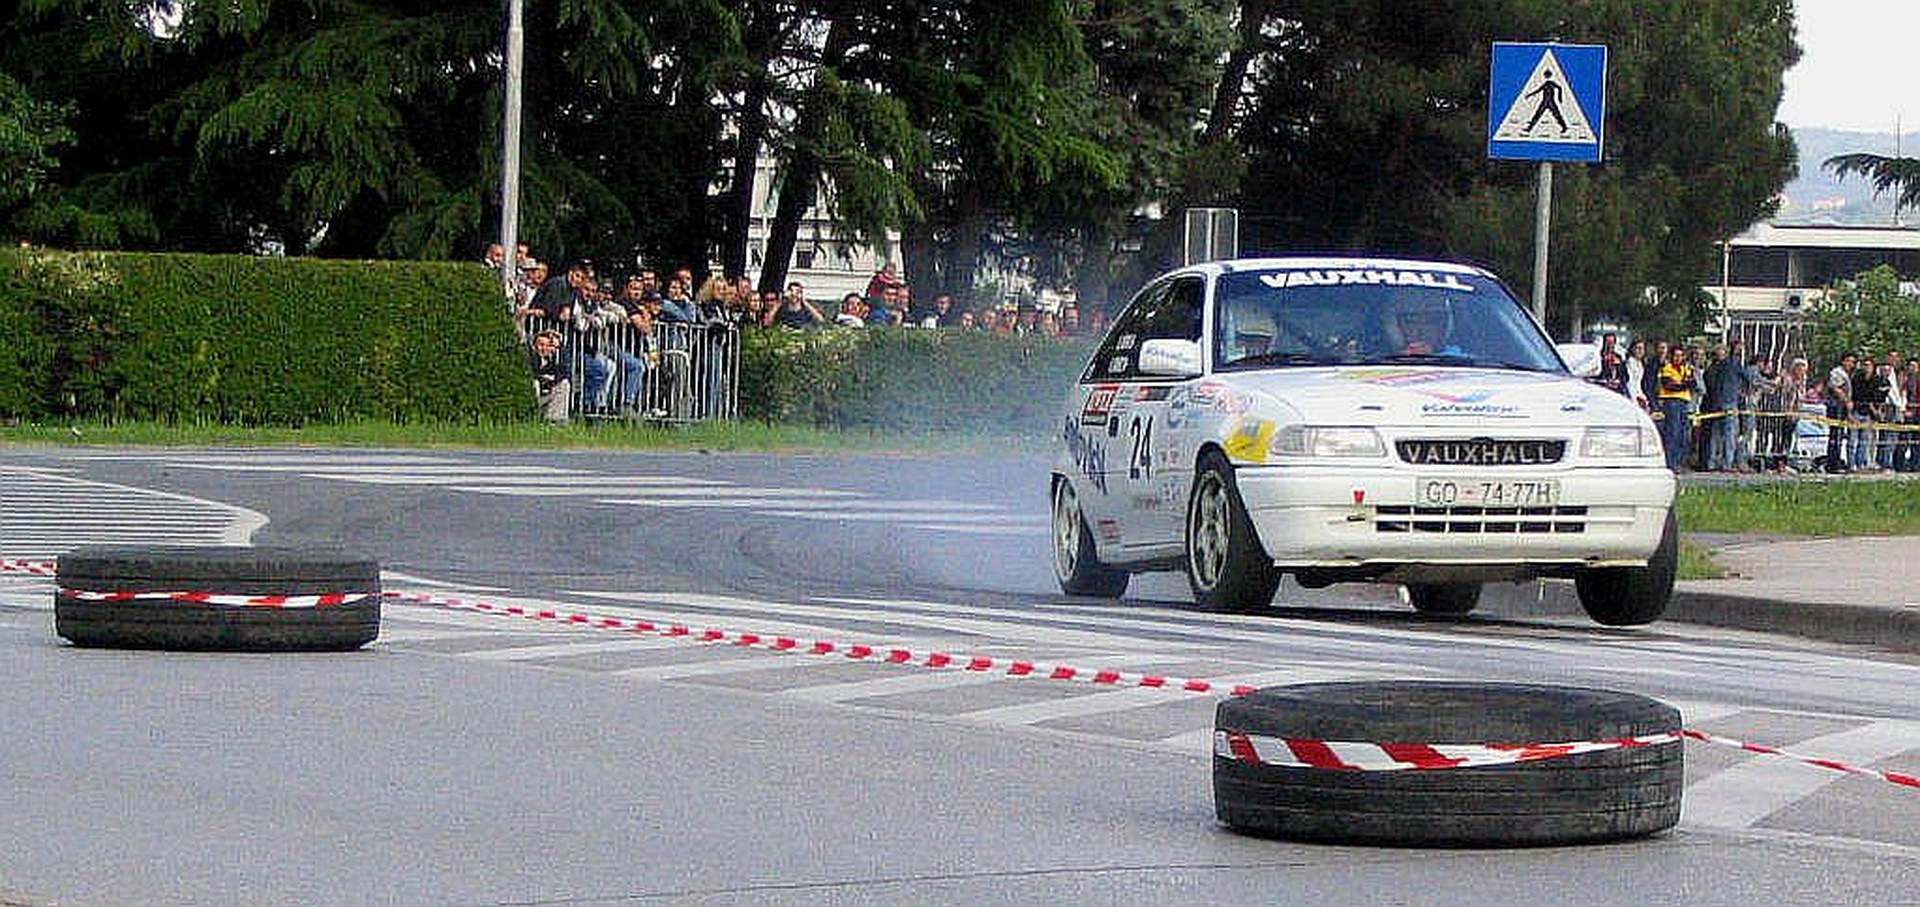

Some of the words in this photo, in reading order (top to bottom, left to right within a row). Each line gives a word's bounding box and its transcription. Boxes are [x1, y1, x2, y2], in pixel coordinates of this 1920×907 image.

[1259, 270, 1475, 292] VAUXHALL
[1129, 415, 1155, 484] 24
[1405, 442, 1553, 465] VAUXHALL
[1425, 480, 1458, 504] GO
[1480, 482, 1551, 504] 74-77H
